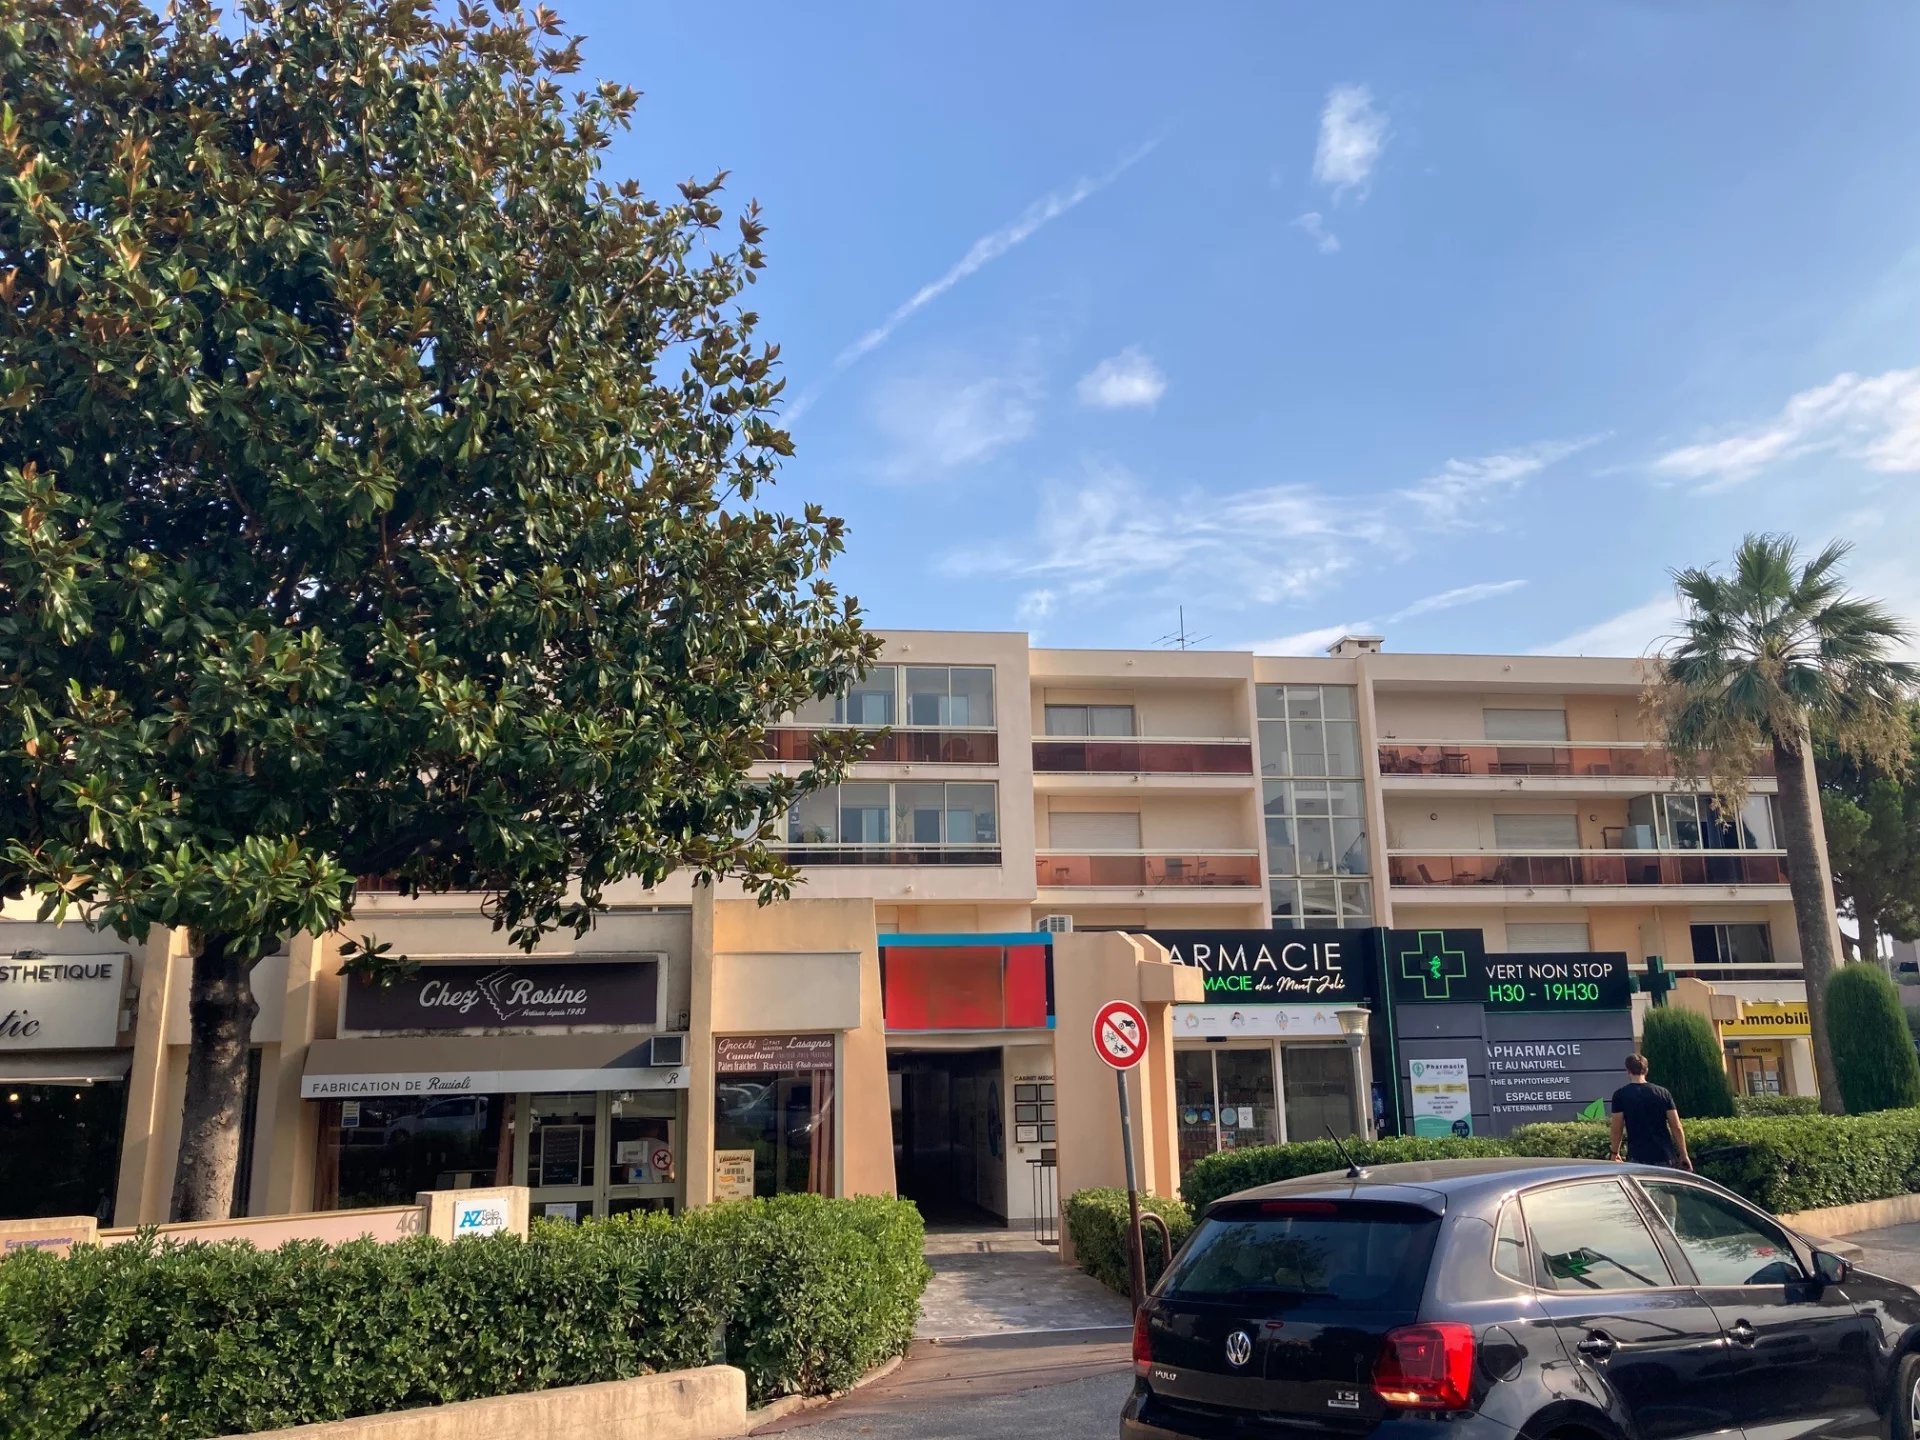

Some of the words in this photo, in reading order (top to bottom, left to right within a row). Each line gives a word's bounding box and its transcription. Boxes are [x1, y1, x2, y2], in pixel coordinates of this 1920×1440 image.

[1169, 943, 1342, 972] ARMACIE
[0, 964, 112, 981] STHETIQUE
[1485, 965, 1523, 979] VERT
[1529, 964, 1568, 979] NON
[1573, 963, 1613, 978] STOP
[1255, 976, 1273, 991] du
[1276, 976, 1319, 994] Mont
[1316, 973, 1346, 994] Joli
[419, 980, 480, 1014] Chez
[506, 978, 588, 1005] Rosine
[1489, 984, 1525, 1002] H30
[1544, 983, 1599, 1001] 19H30
[521, 1008, 546, 1017] Artisan
[547, 1008, 566, 1018] depuis
[566, 1007, 587, 1016] 1983
[717, 1038, 757, 1055] Gnocchi
[786, 1036, 832, 1052] Lasagnes
[726, 1051, 775, 1061] Cannelloni
[762, 1061, 794, 1071] Ravioli
[1505, 1062, 1519, 1071] AU
[1520, 1059, 1567, 1070] NATUREL
[312, 1081, 400, 1093] FABRICATION
[405, 1081, 422, 1091] DE
[426, 1076, 472, 1090] Ravioli
[1513, 1076, 1571, 1086] PHYTOTHERAPIE
[1505, 1091, 1544, 1102] ESPACE
[1545, 1090, 1572, 1100] BEBE
[1502, 1104, 1553, 1113] VETERINAIRES
[395, 1211, 420, 1233] 46
[459, 1209, 482, 1228] AZ
